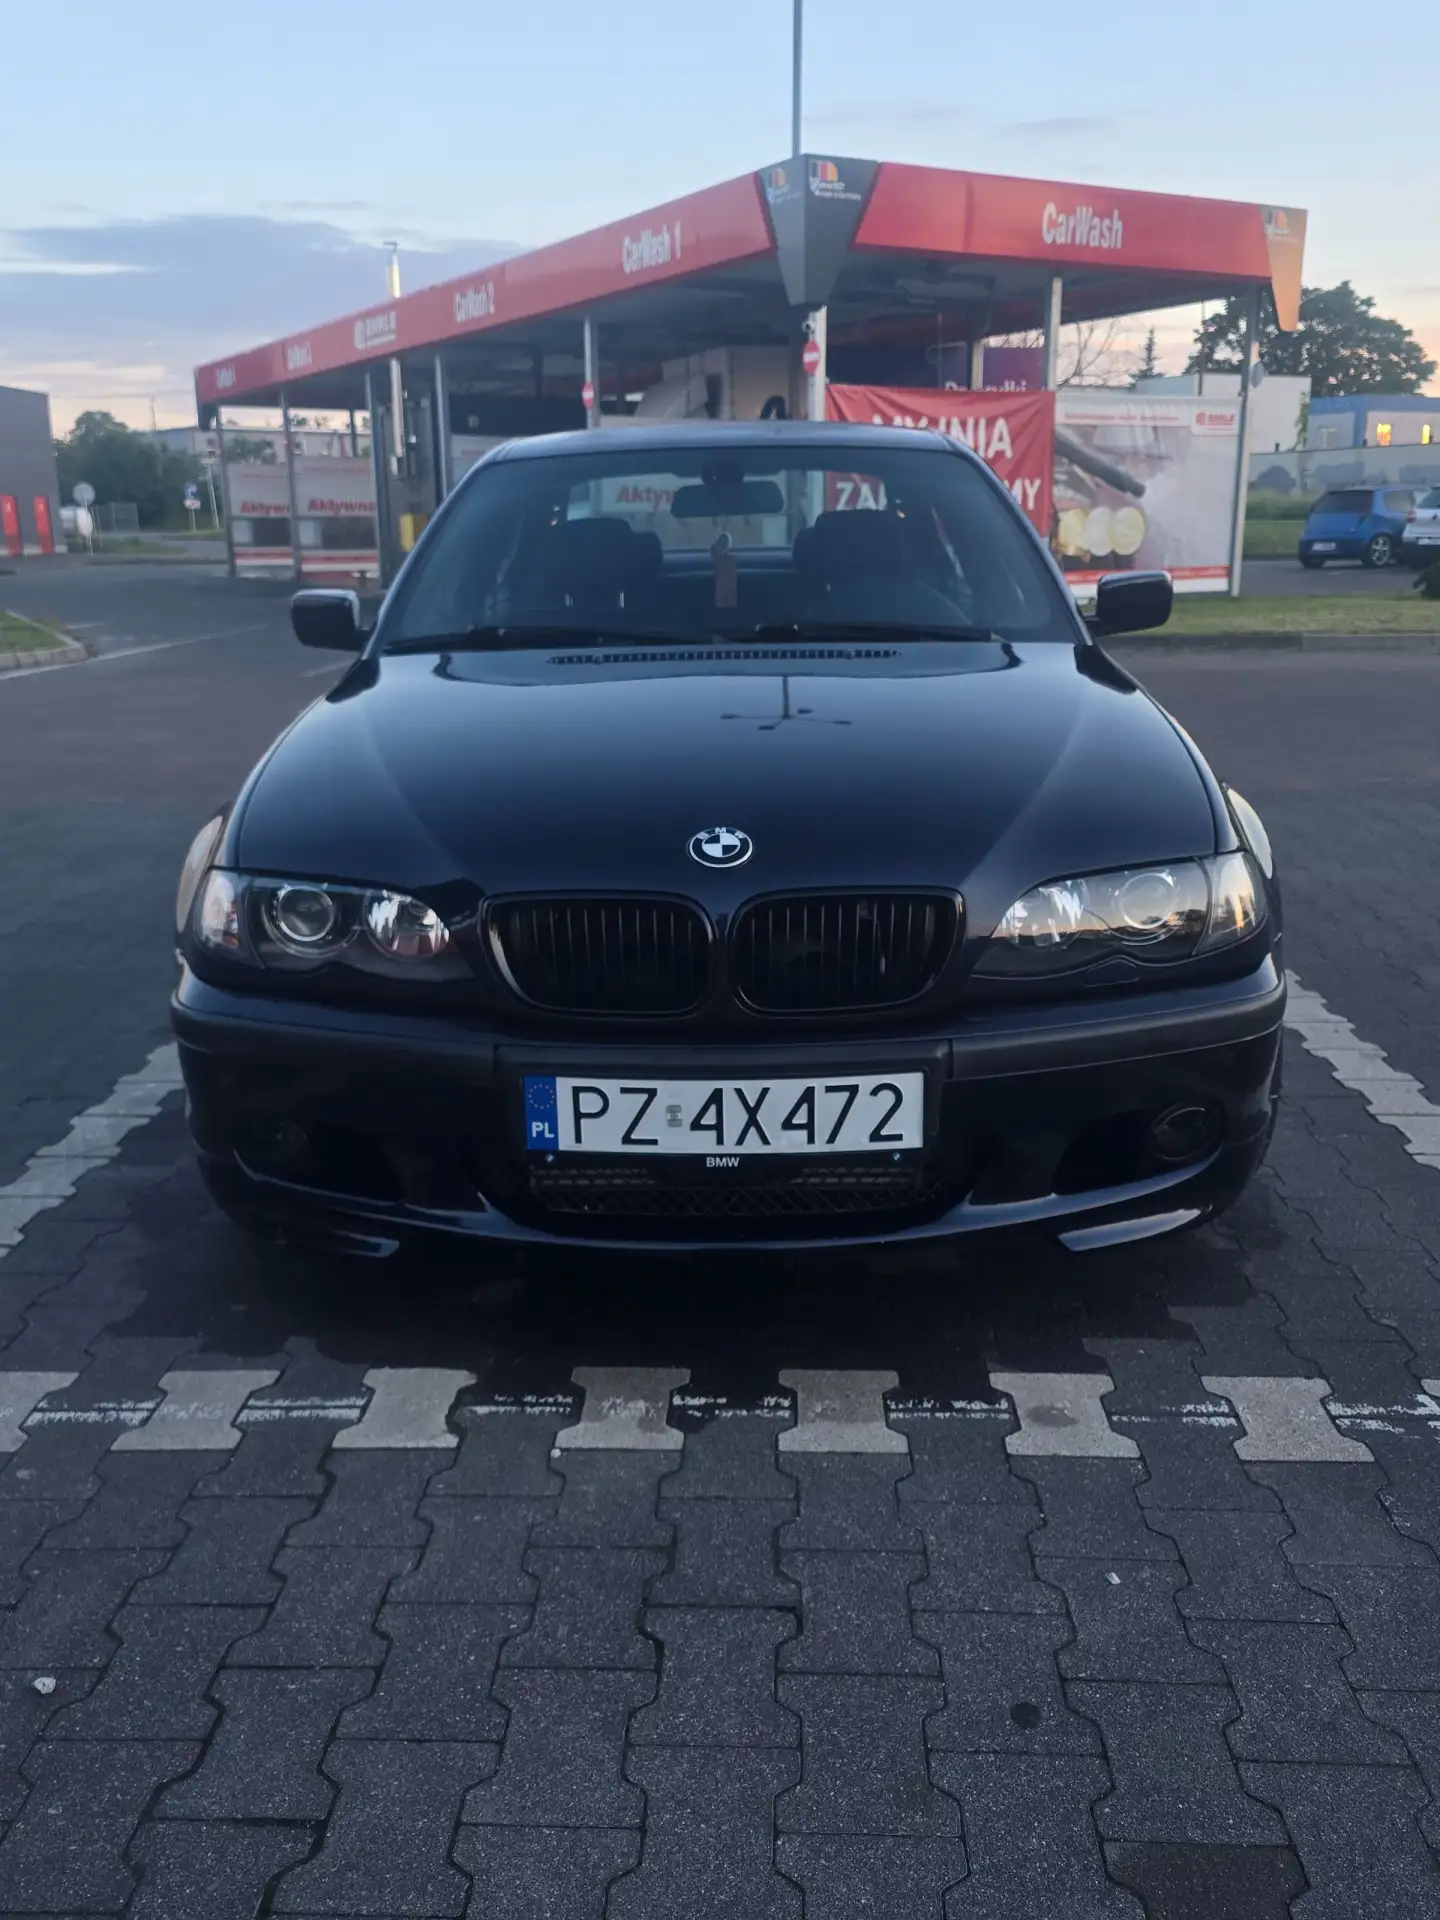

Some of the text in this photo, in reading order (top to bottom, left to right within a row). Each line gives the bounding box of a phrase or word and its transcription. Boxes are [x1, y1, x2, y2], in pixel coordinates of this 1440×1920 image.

[622, 220, 681, 275] CarWash 1
[1042, 202, 1123, 249] CarWash
[531, 1121, 555, 1138] PL
[572, 1082, 904, 1146] PZ 4X472
[706, 1156, 740, 1168] BMW
